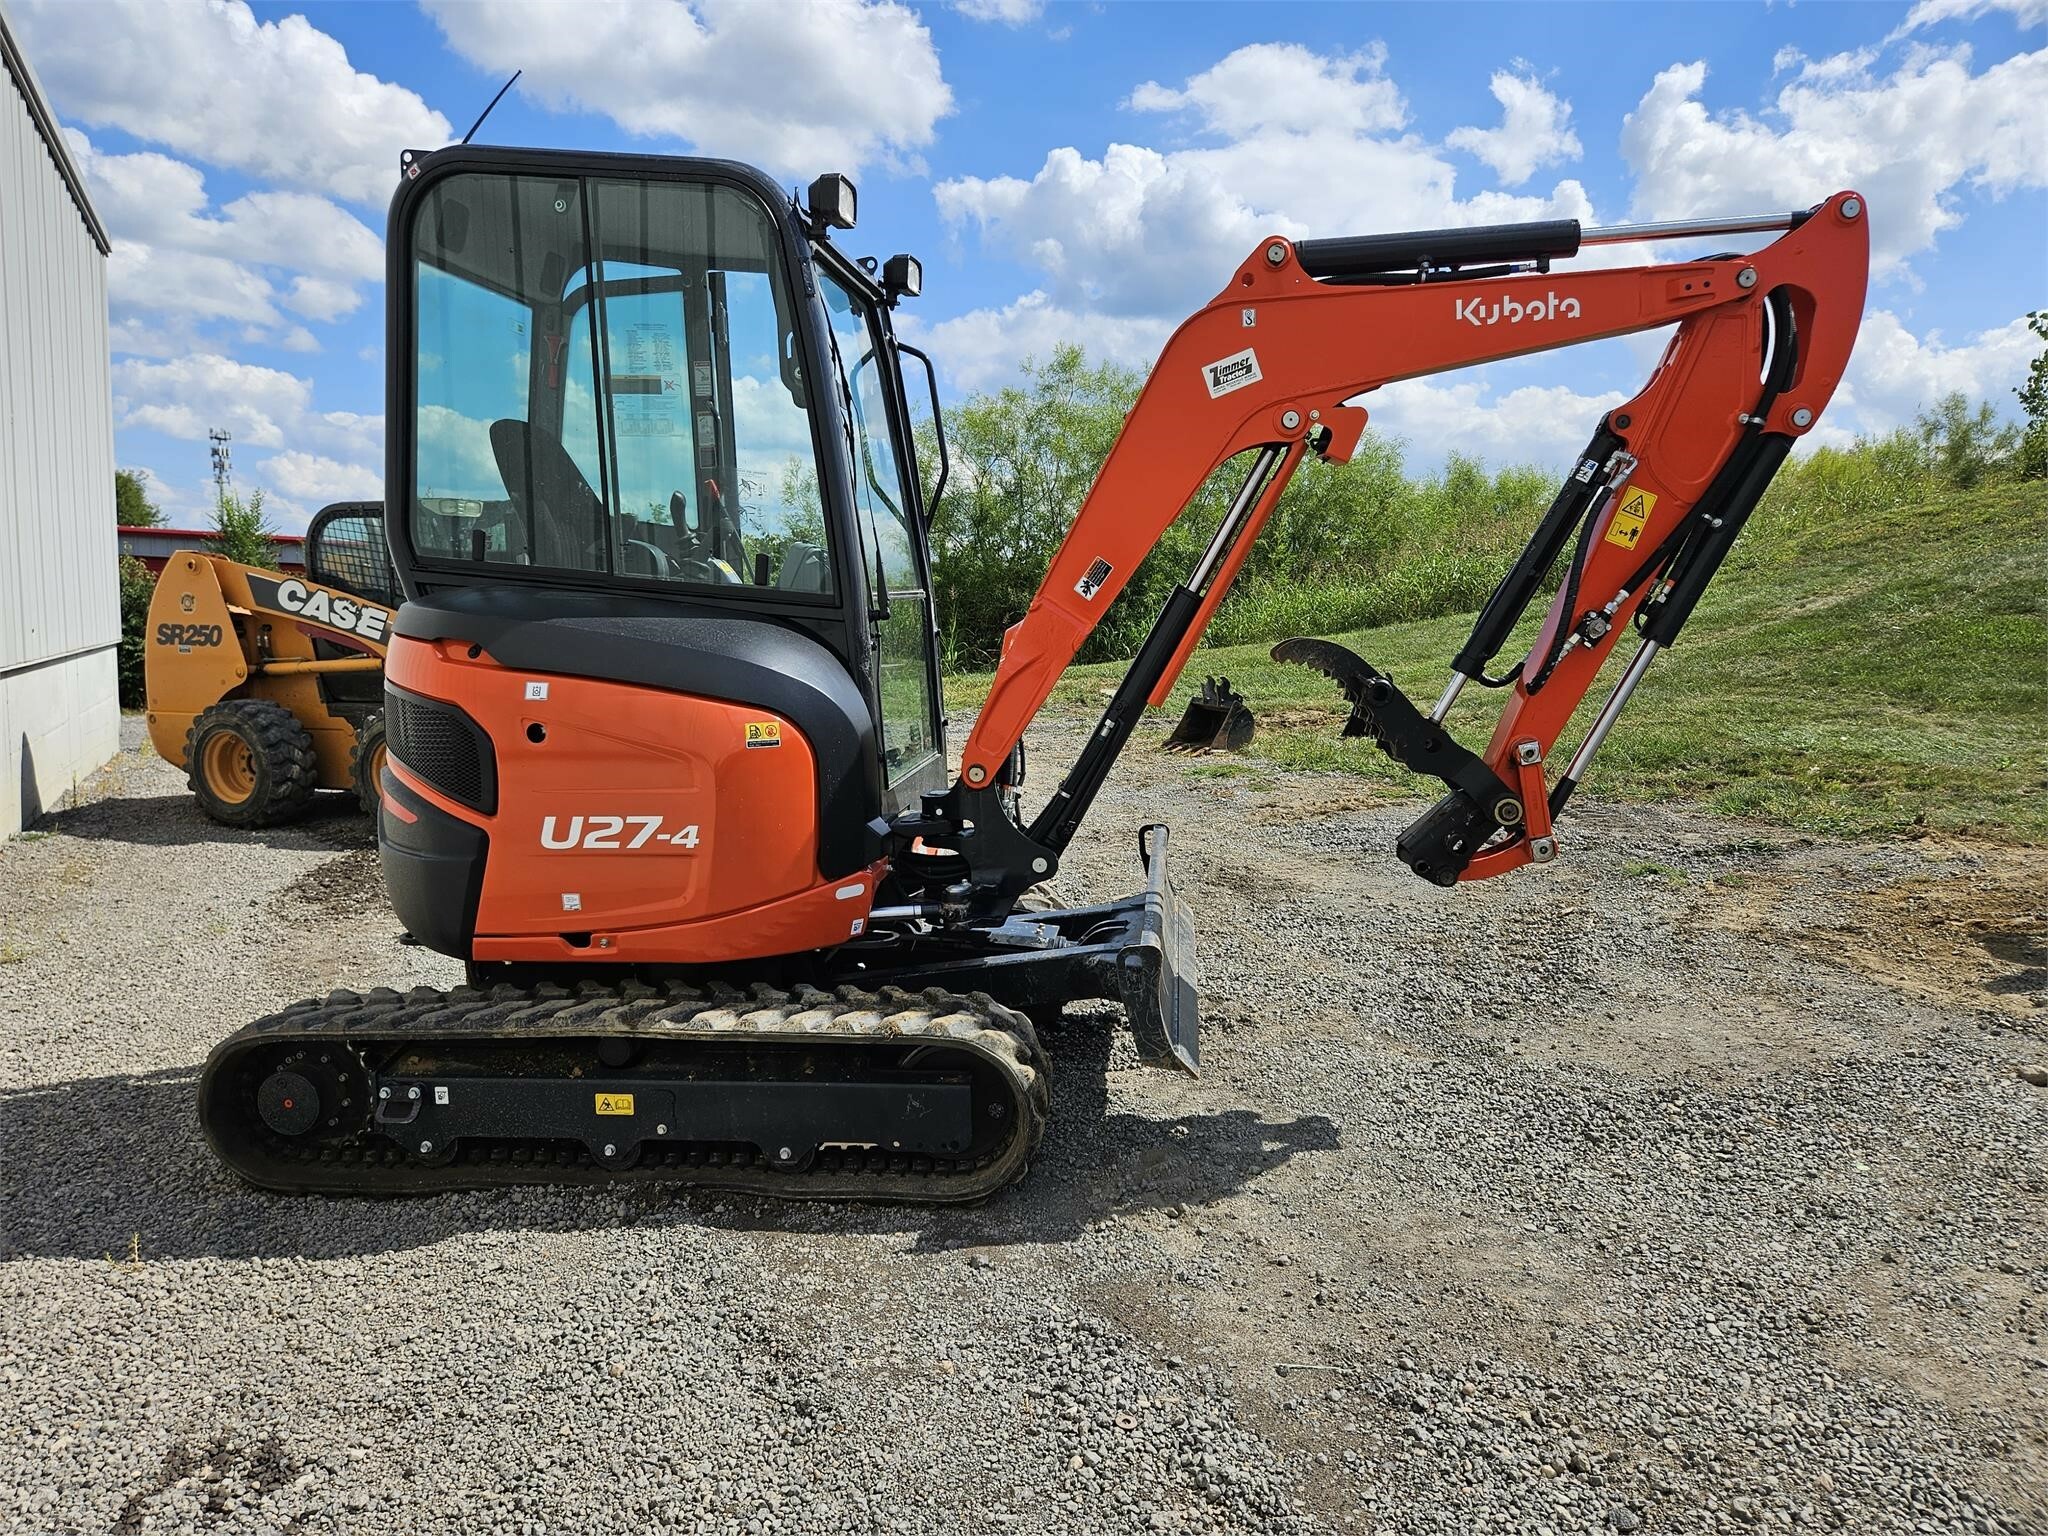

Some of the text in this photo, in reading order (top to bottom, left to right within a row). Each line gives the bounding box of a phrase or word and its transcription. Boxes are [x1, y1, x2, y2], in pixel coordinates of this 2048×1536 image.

[1455, 291, 1581, 326] Kubota
[1209, 356, 1250, 388] Zimmer
[1219, 368, 1247, 384] Tractor
[277, 579, 389, 640] CASE
[156, 623, 223, 647] SR250
[540, 815, 700, 850] U27-4
